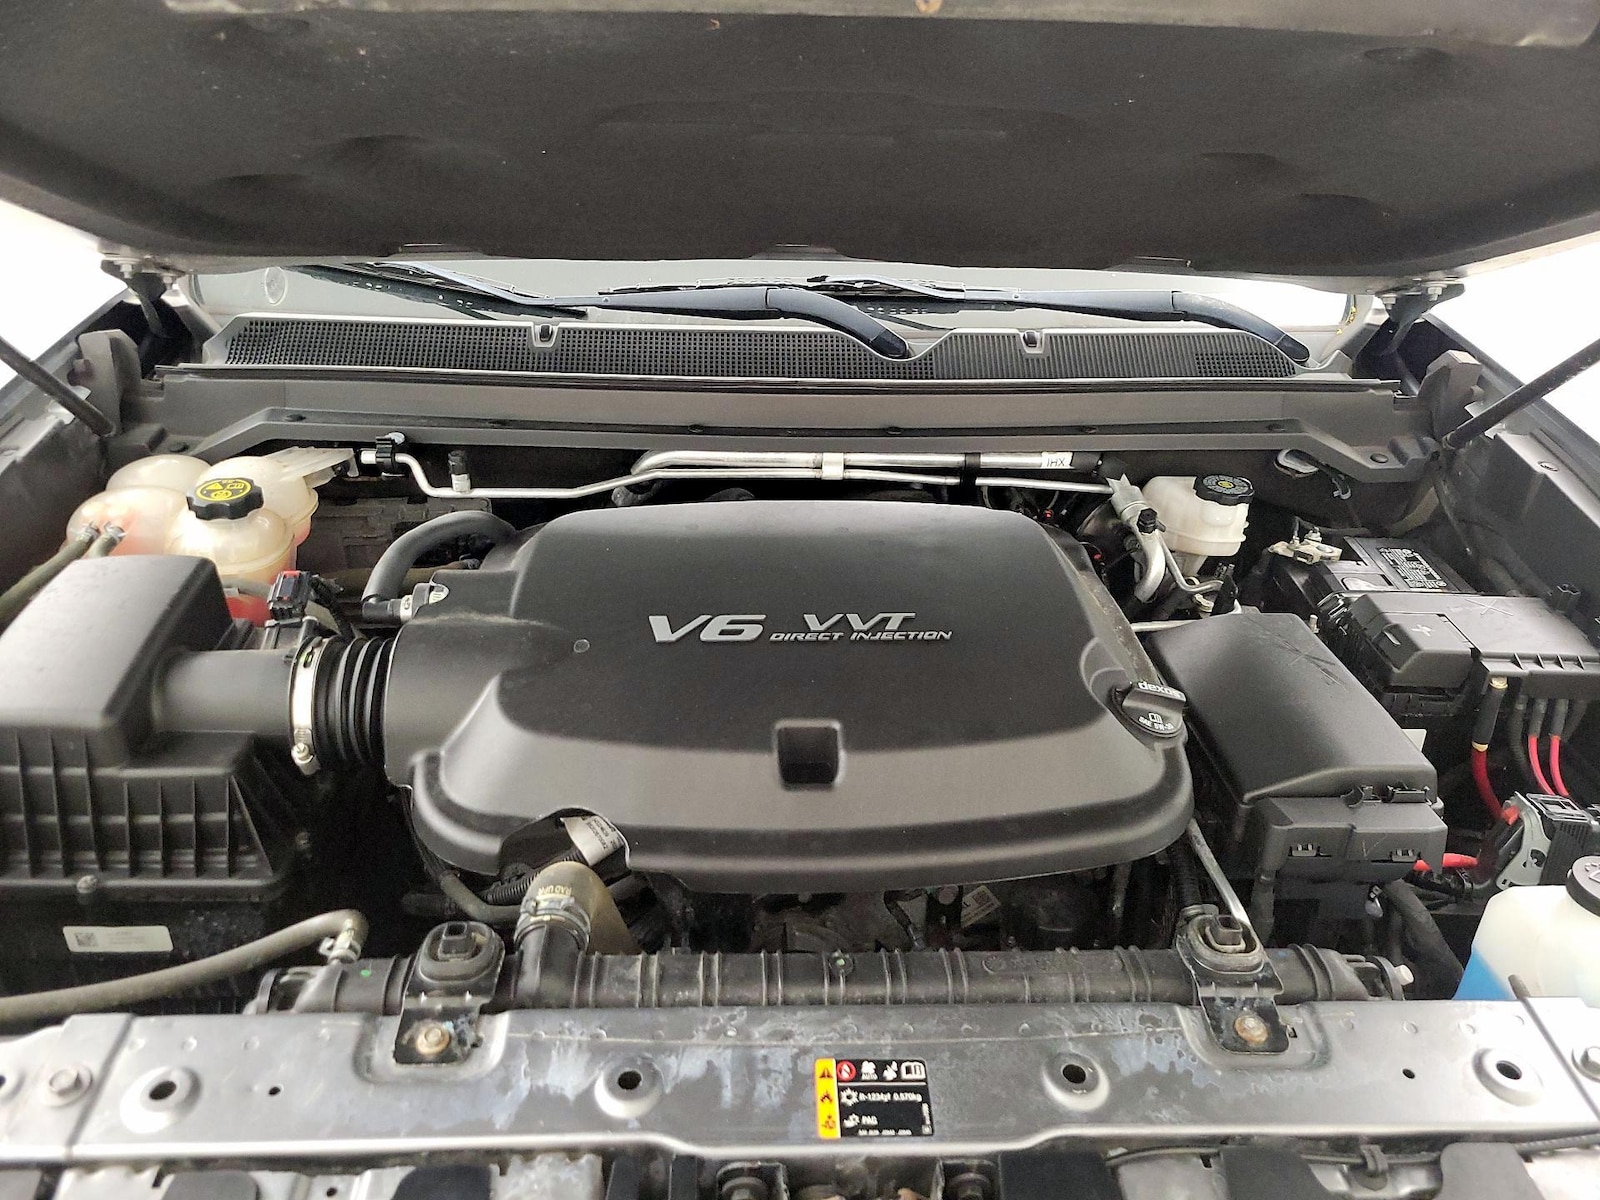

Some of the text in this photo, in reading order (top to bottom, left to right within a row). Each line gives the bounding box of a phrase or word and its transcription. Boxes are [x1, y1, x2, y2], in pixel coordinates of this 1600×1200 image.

[648, 615, 767, 642] V6
[803, 612, 917, 631] VVT
[769, 630, 952, 642] DIRECT INJECTION
